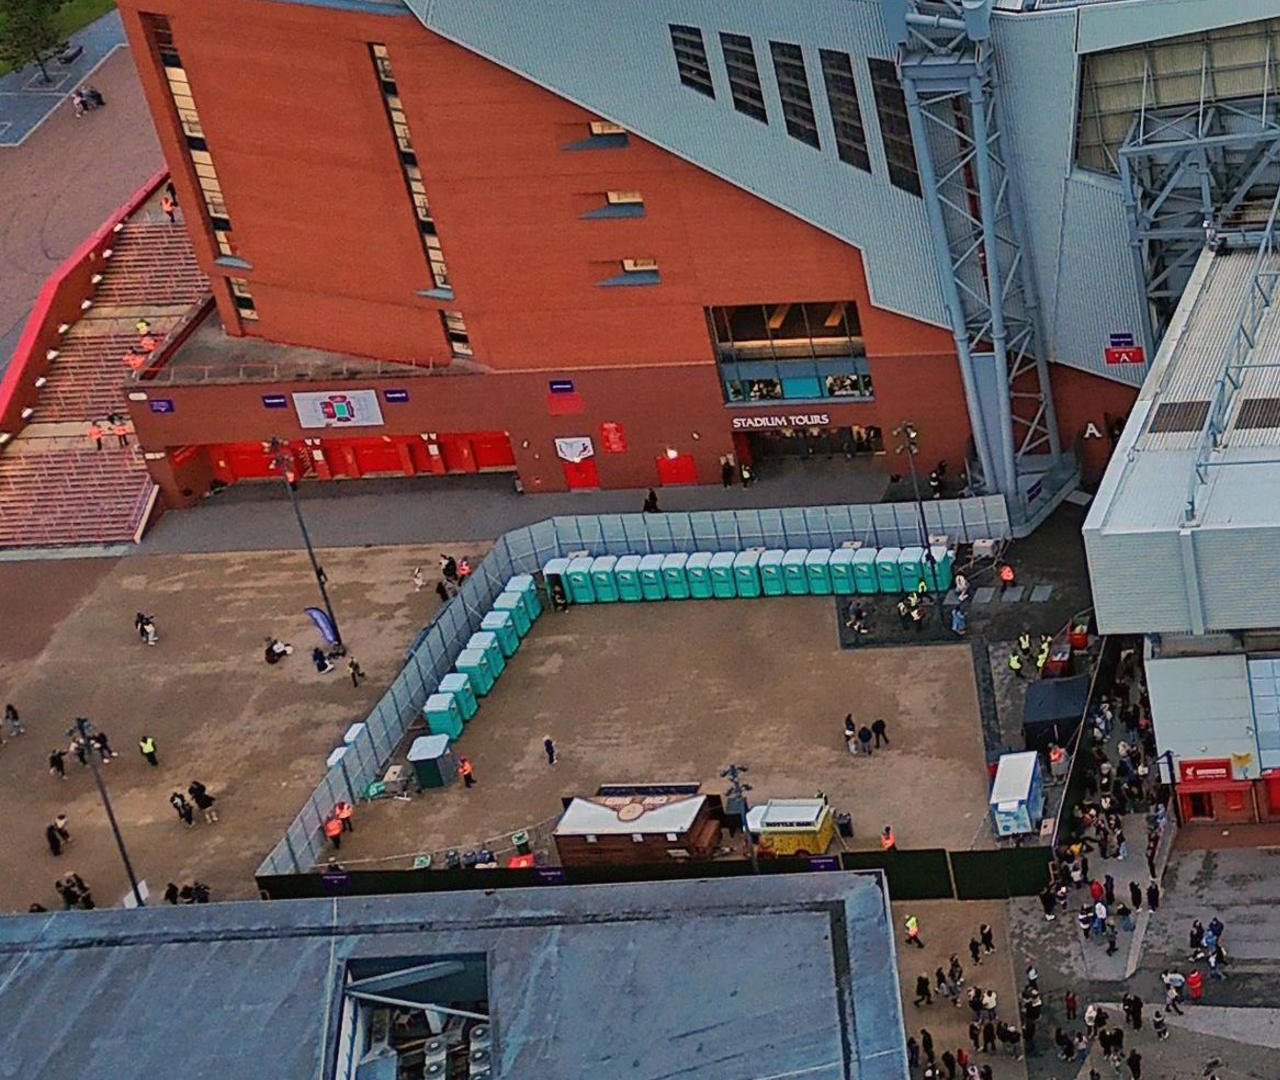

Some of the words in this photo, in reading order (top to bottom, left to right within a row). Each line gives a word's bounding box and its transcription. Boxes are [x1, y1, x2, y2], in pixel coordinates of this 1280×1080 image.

[733, 416, 787, 428] STADIUM
[789, 414, 829, 426] TOURS
[1084, 423, 1102, 438] A
